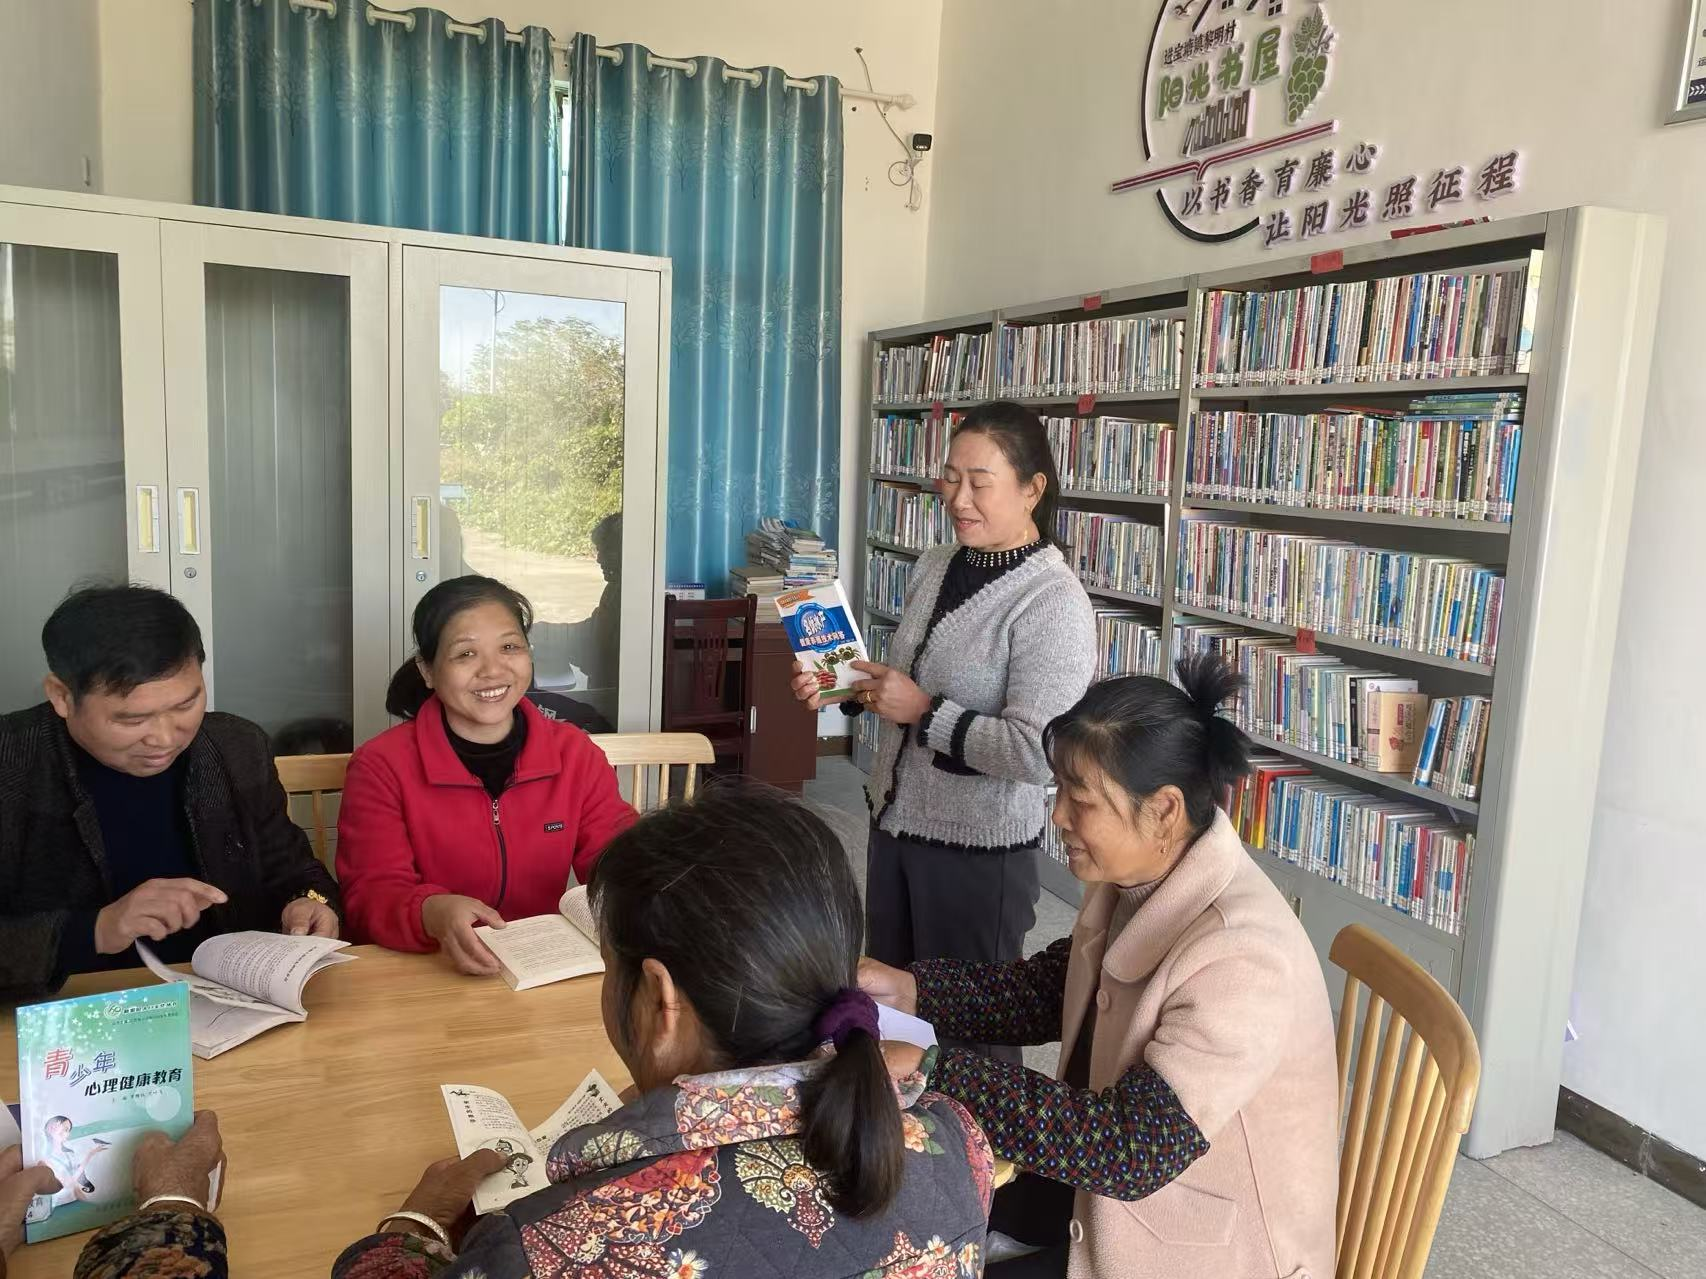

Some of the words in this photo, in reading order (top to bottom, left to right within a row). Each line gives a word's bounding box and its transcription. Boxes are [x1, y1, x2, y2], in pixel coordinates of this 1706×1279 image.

[1158, 27, 1281, 118] 阳光书屋
[1181, 144, 1377, 215] 以书香育廉心
[1265, 152, 1518, 246] 让阳光照征程
[44, 1047, 116, 1087] 青少年
[85, 1068, 183, 1096] 心理健康教育
